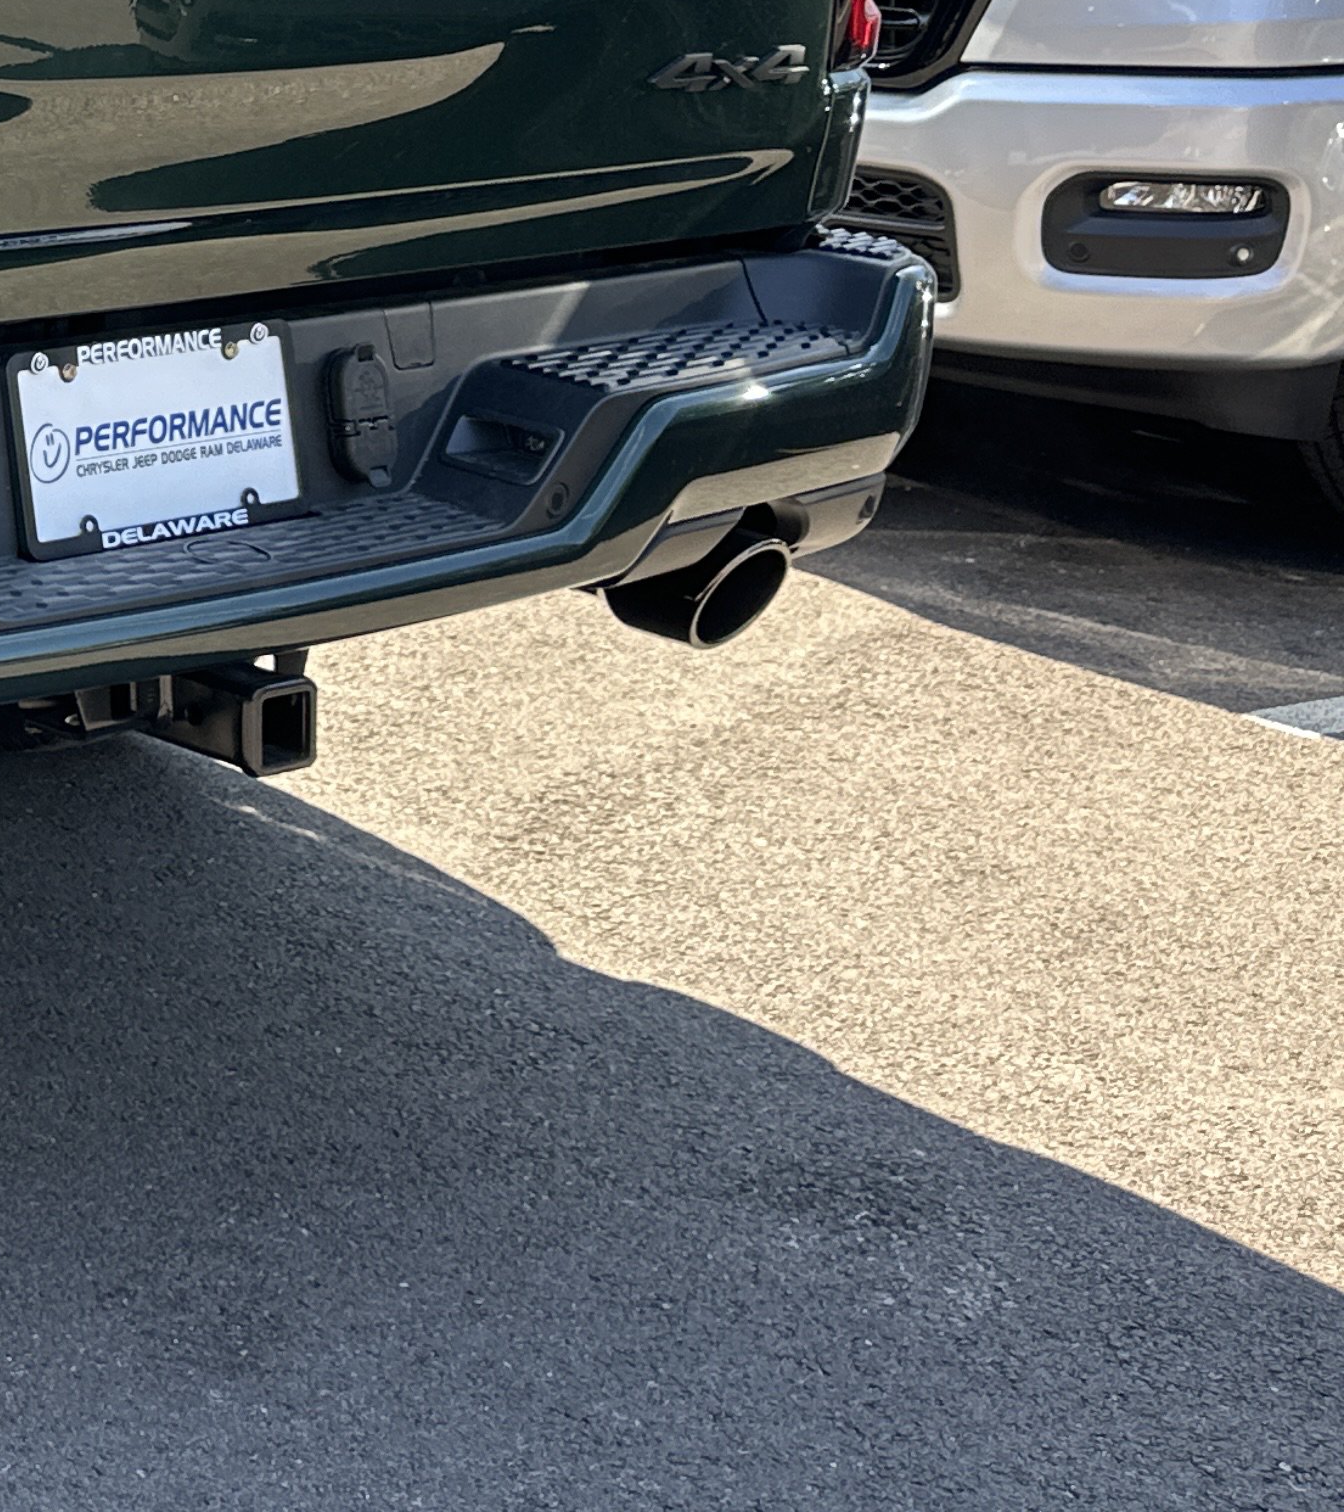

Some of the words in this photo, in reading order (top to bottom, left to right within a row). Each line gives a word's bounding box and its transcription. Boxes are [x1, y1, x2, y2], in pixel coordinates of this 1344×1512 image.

[76, 327, 223, 366] PERFORMANCE
[74, 397, 282, 456] PERFORMANCE
[76, 457, 130, 478] CHRYSLER
[132, 453, 158, 470] JEEP
[161, 447, 198, 465] DODGE
[200, 442, 223, 459] RAM
[226, 434, 283, 455] DELAWARE
[101, 507, 249, 549] DELAWARE
